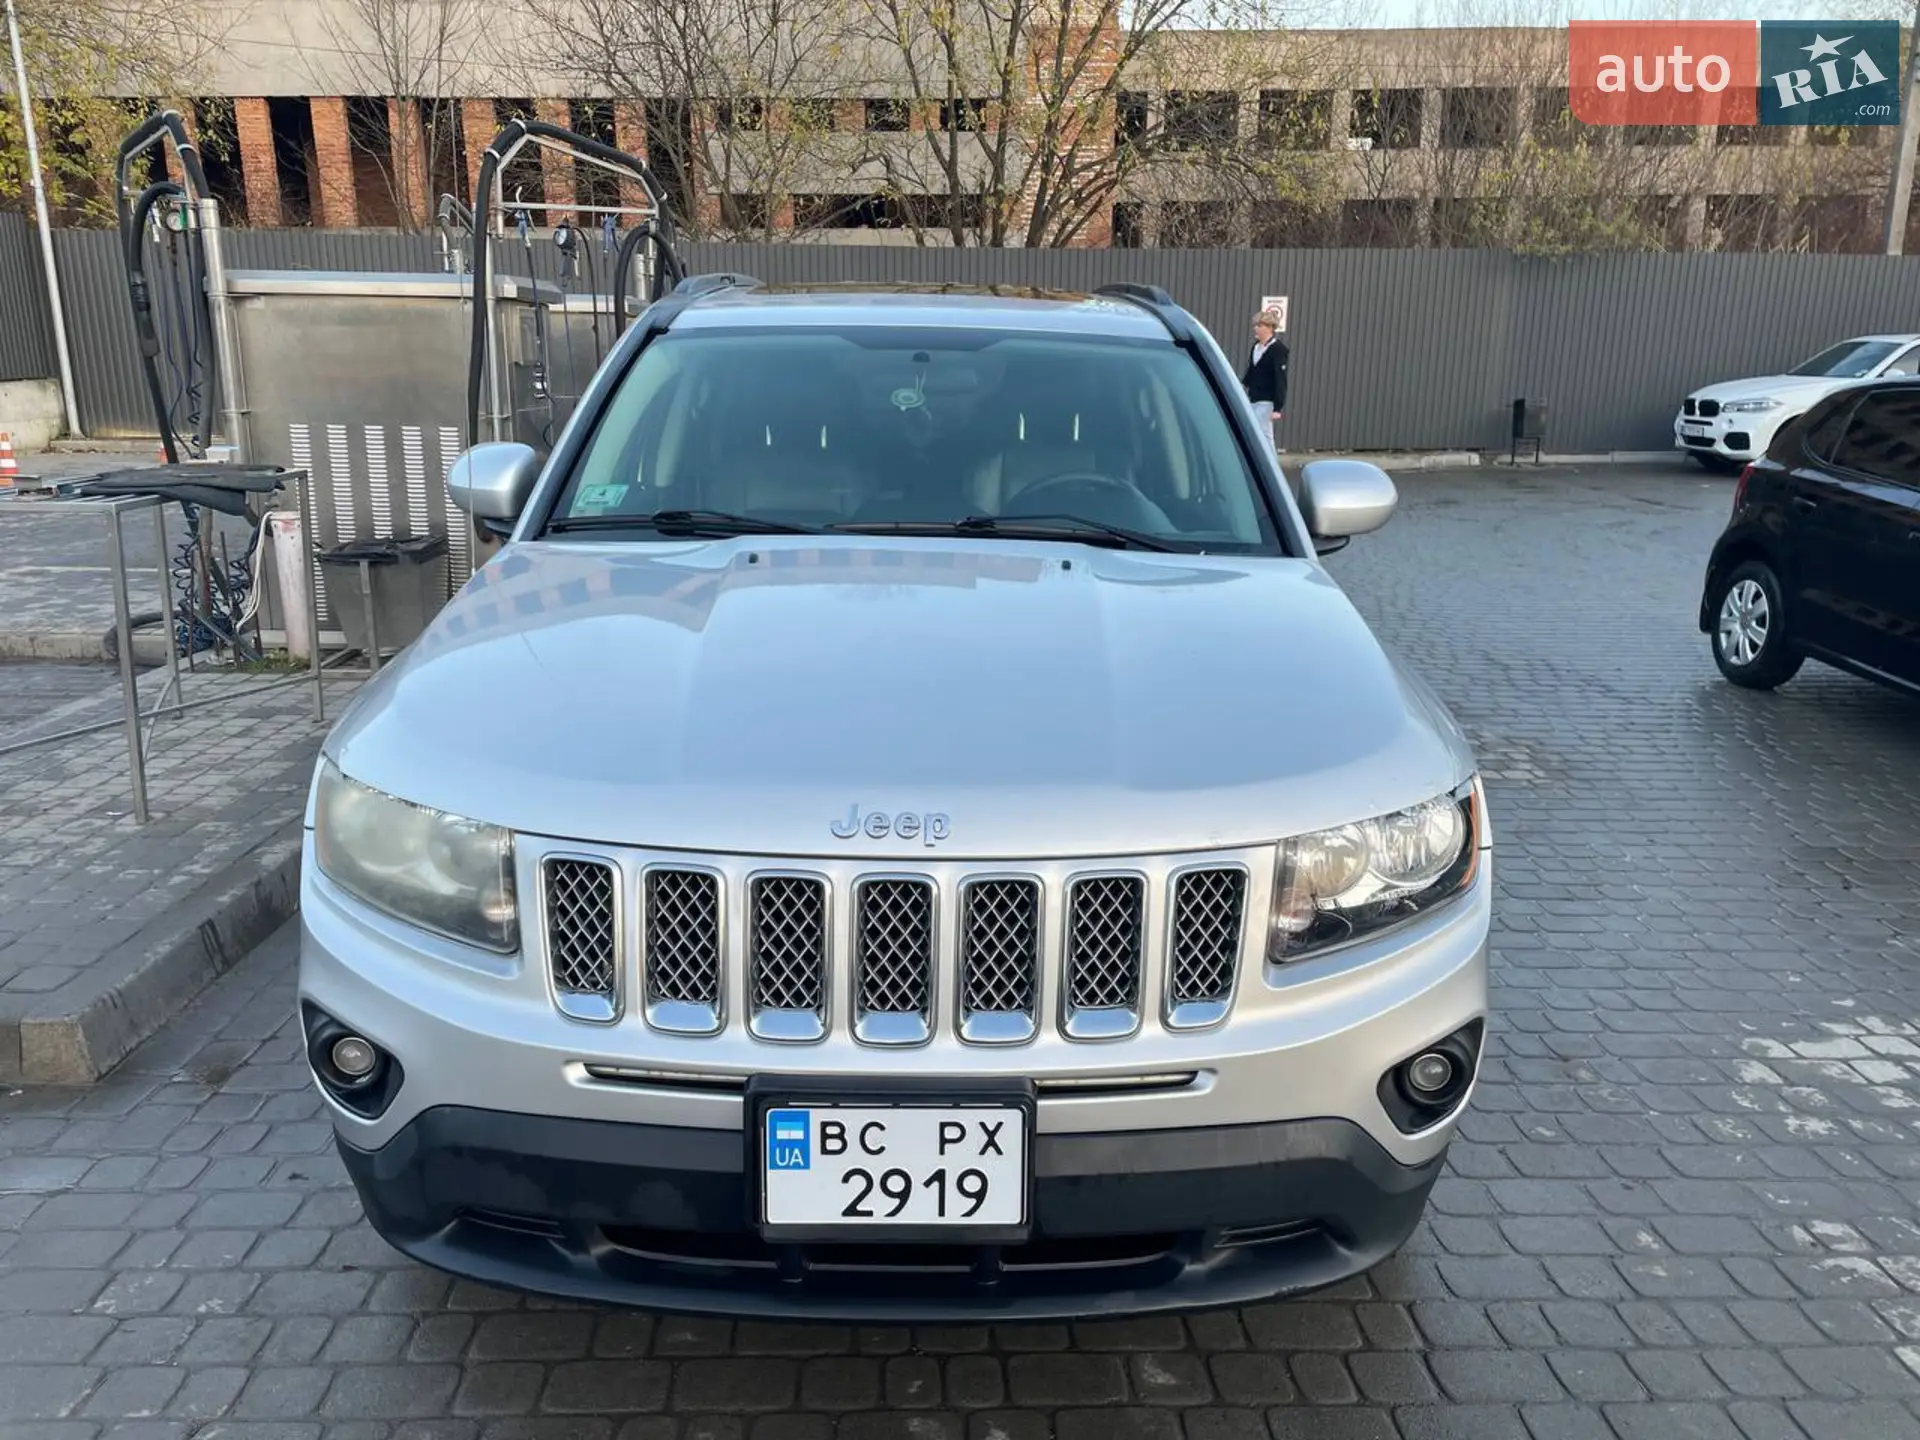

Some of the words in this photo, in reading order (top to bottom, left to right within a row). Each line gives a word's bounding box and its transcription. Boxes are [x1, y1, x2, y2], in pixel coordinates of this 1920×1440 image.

[830, 803, 951, 847] Jeep
[775, 1148, 804, 1167] UA
[820, 1121, 887, 1156] BC
[939, 1121, 1004, 1156] PX
[840, 1168, 989, 1218] 2919
